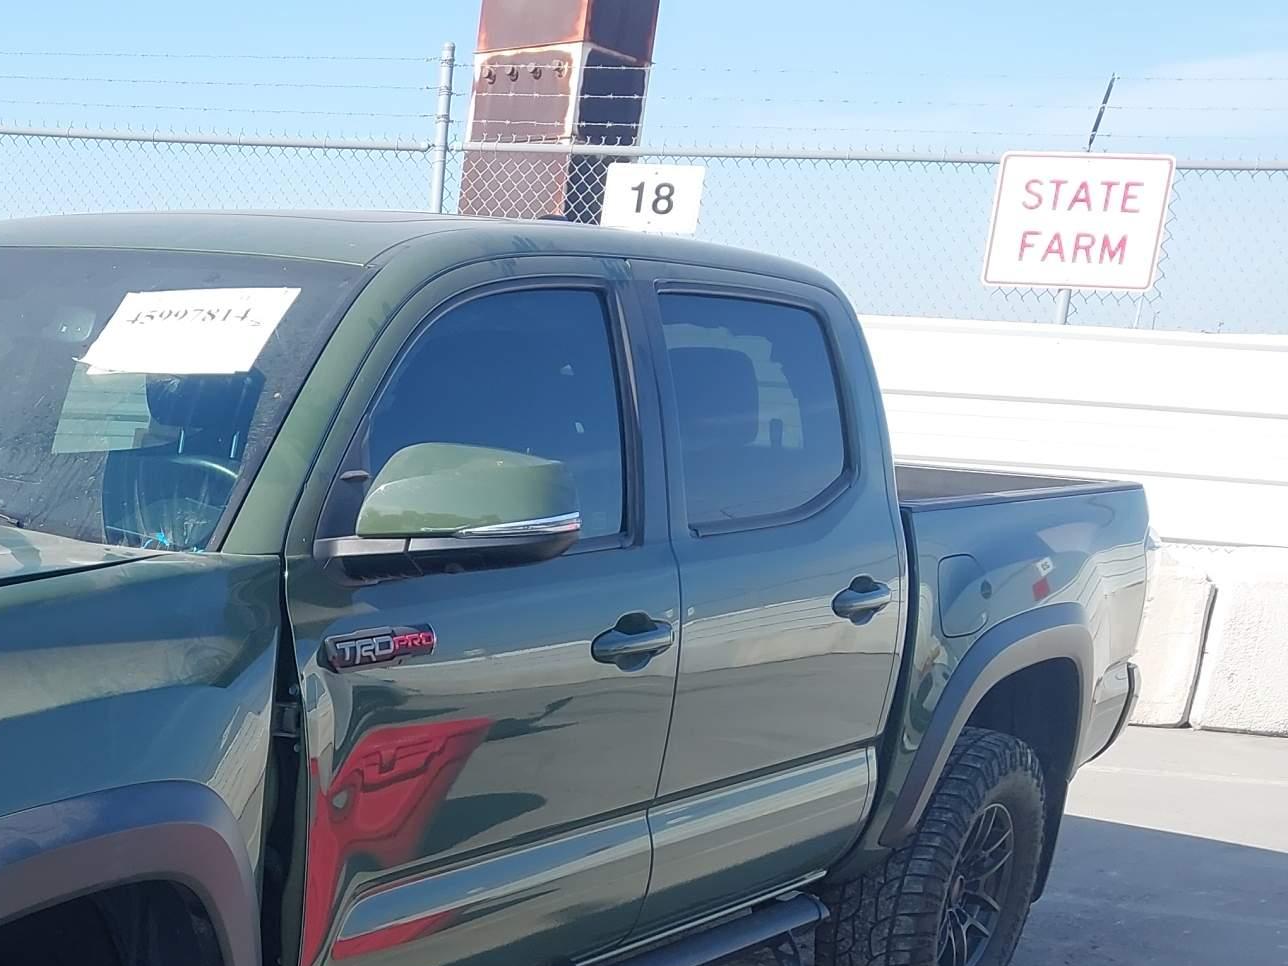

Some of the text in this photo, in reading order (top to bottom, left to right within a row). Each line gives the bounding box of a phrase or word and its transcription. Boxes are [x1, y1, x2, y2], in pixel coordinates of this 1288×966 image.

[630, 181, 676, 216] 18
[1021, 178, 1145, 214] STATE
[1016, 230, 1128, 266] FARM
[335, 631, 434, 665] TRD PRO
